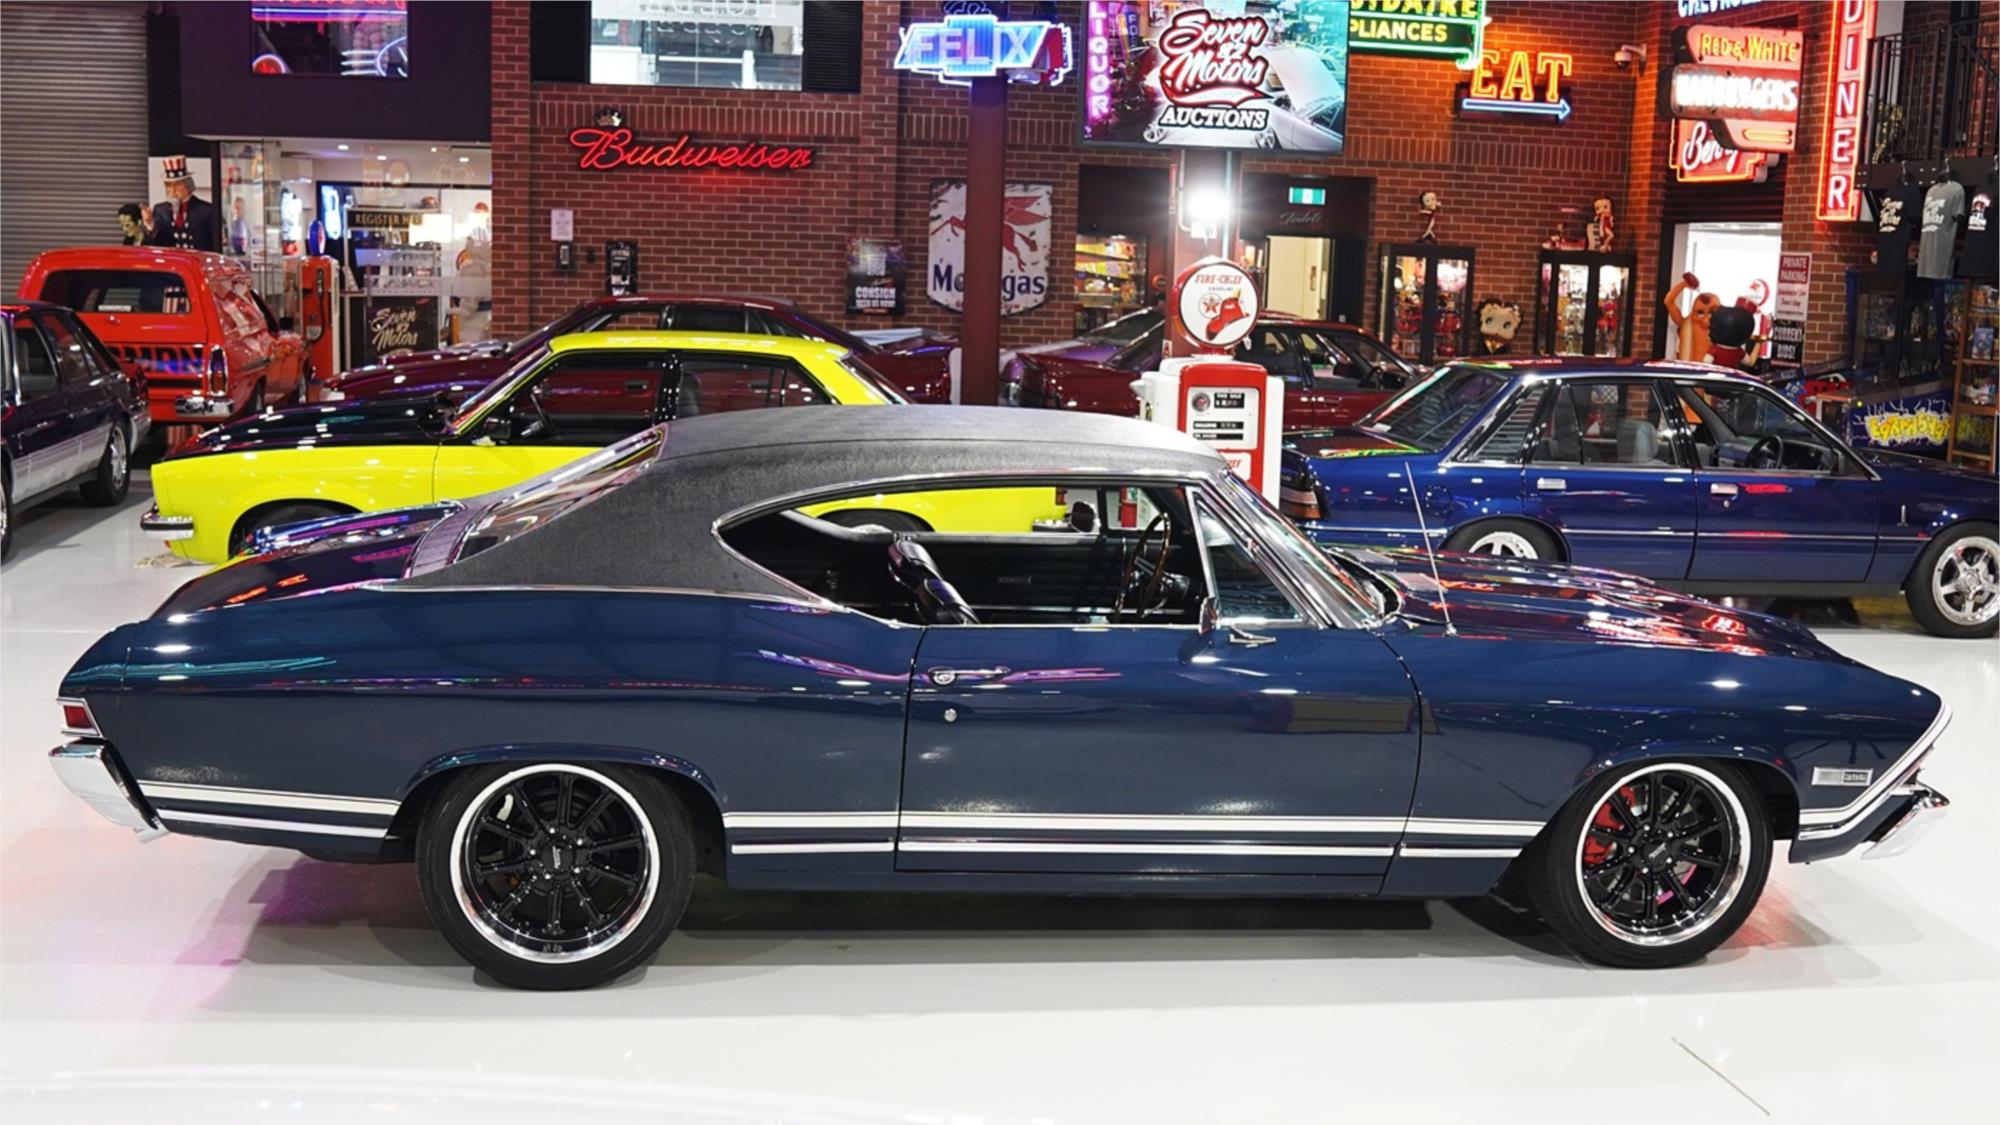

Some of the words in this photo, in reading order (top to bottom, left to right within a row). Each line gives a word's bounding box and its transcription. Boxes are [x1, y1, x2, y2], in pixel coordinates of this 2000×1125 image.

[909, 27, 1031, 66] FELIX
[1163, 11, 1265, 56] Seven
[1747, 36, 1797, 62] WHITE
[1089, 1, 1110, 118] LIQUOR
[1164, 51, 1267, 93] Motors
[1471, 49, 1573, 102] EAT
[1675, 74, 1799, 112] HAMBURGERS
[1827, 0, 1863, 209] DINER
[1160, 107, 1267, 129] AUCTIONS
[570, 129, 812, 170] Budweiser
